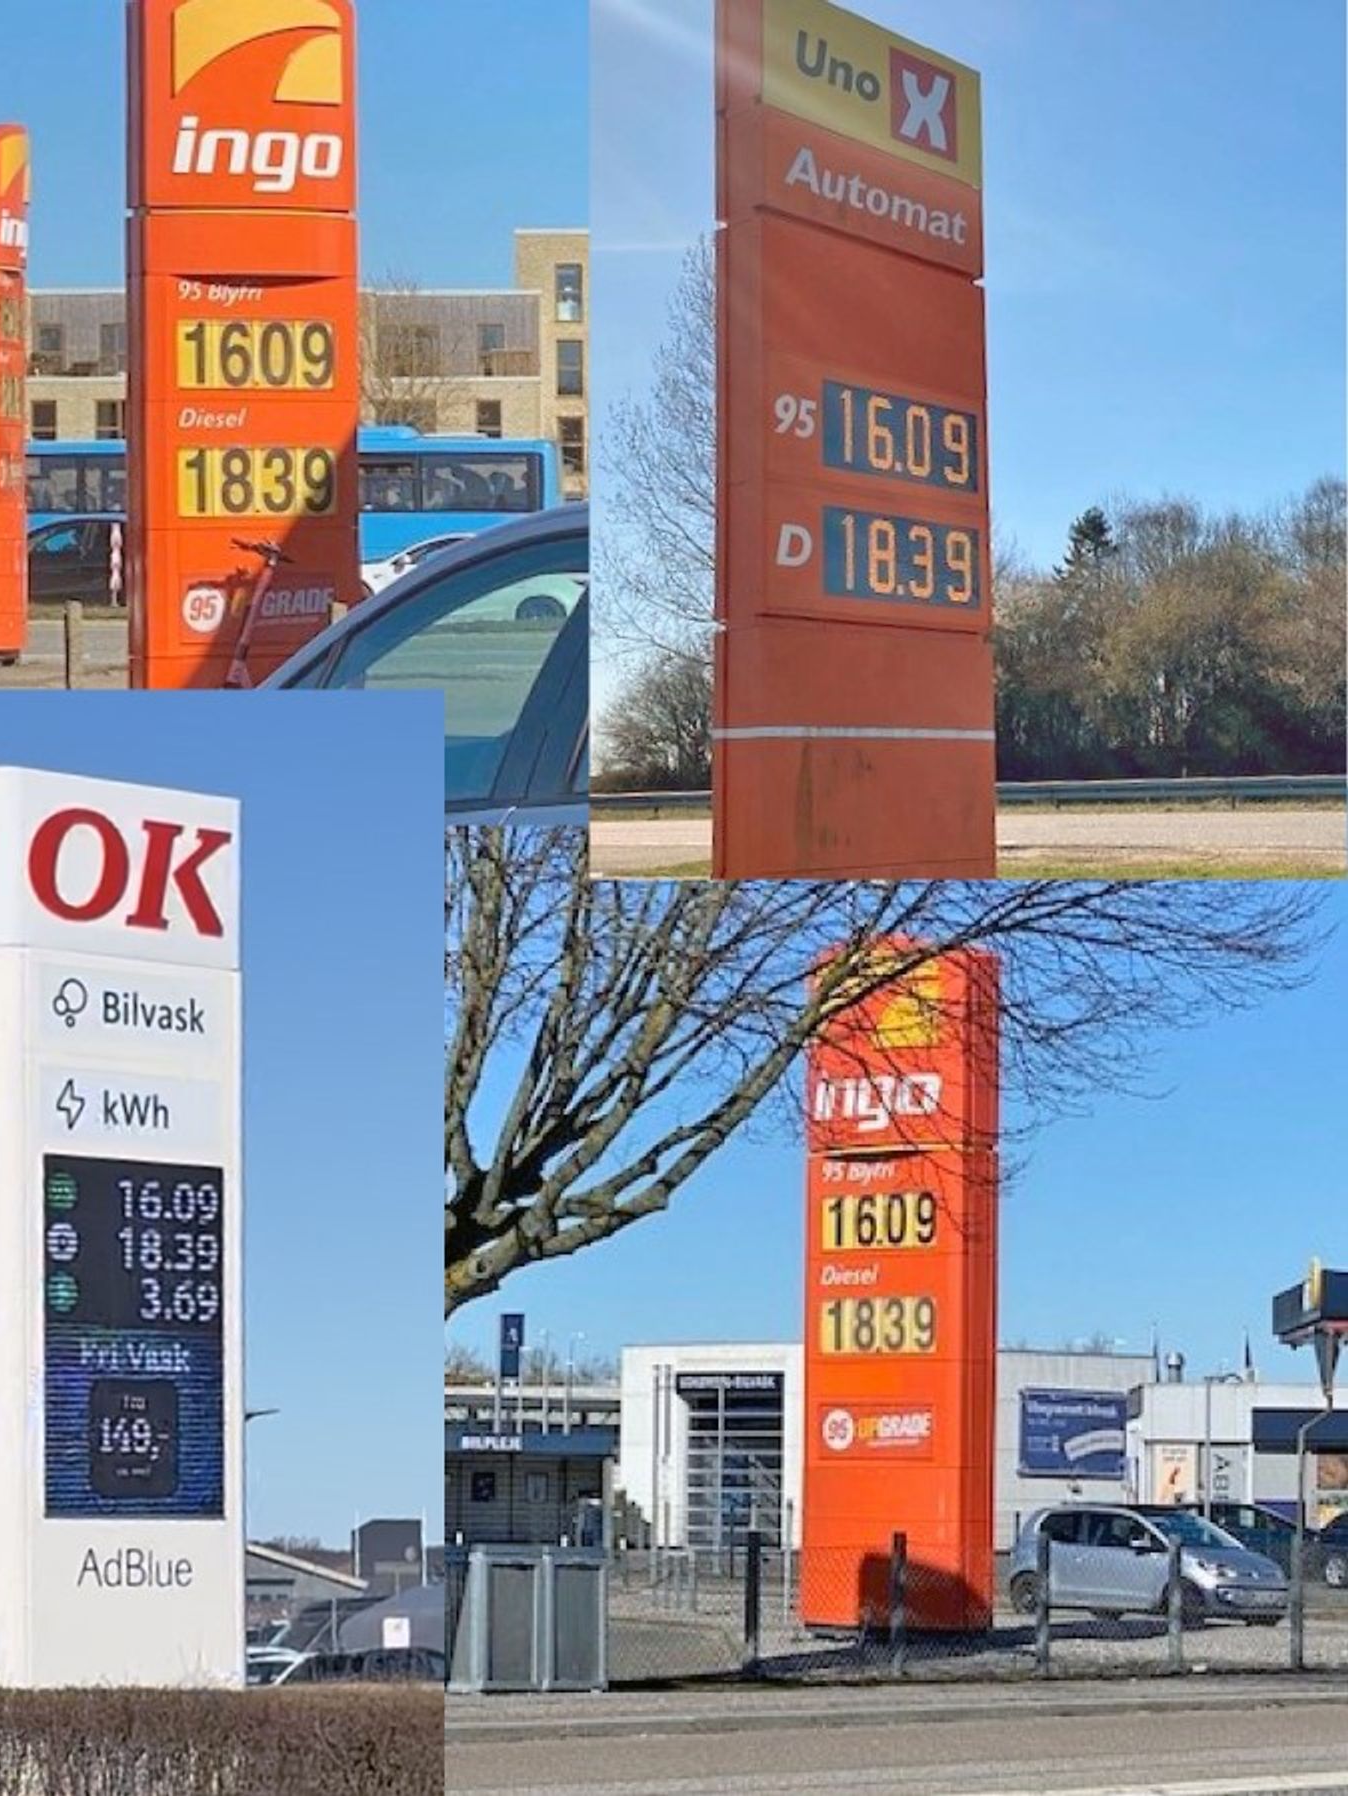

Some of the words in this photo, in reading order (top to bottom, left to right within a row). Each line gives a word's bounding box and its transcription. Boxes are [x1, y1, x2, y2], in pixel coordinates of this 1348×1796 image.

[796, 29, 881, 102] Uno
[899, 68, 951, 152] X
[172, 115, 343, 193] ingo
[784, 146, 968, 245] Automat
[0, 208, 29, 257] in
[178, 280, 202, 300] 95
[178, 407, 247, 428] Diesel
[774, 393, 817, 440] 95
[840, 389, 970, 485] 16.09
[776, 523, 813, 567] D
[842, 513, 973, 603] 18.39
[190, 595, 217, 621] 95
[28, 808, 232, 937] OK
[102, 990, 205, 1034] Bilvask
[103, 1089, 169, 1129] kWh
[119, 1180, 218, 1225] 16.09
[119, 1226, 218, 1271] 18.39
[820, 1264, 878, 1286] Diesel
[140, 1277, 219, 1322] 3.69
[77, 1547, 193, 1588] AdBlue
